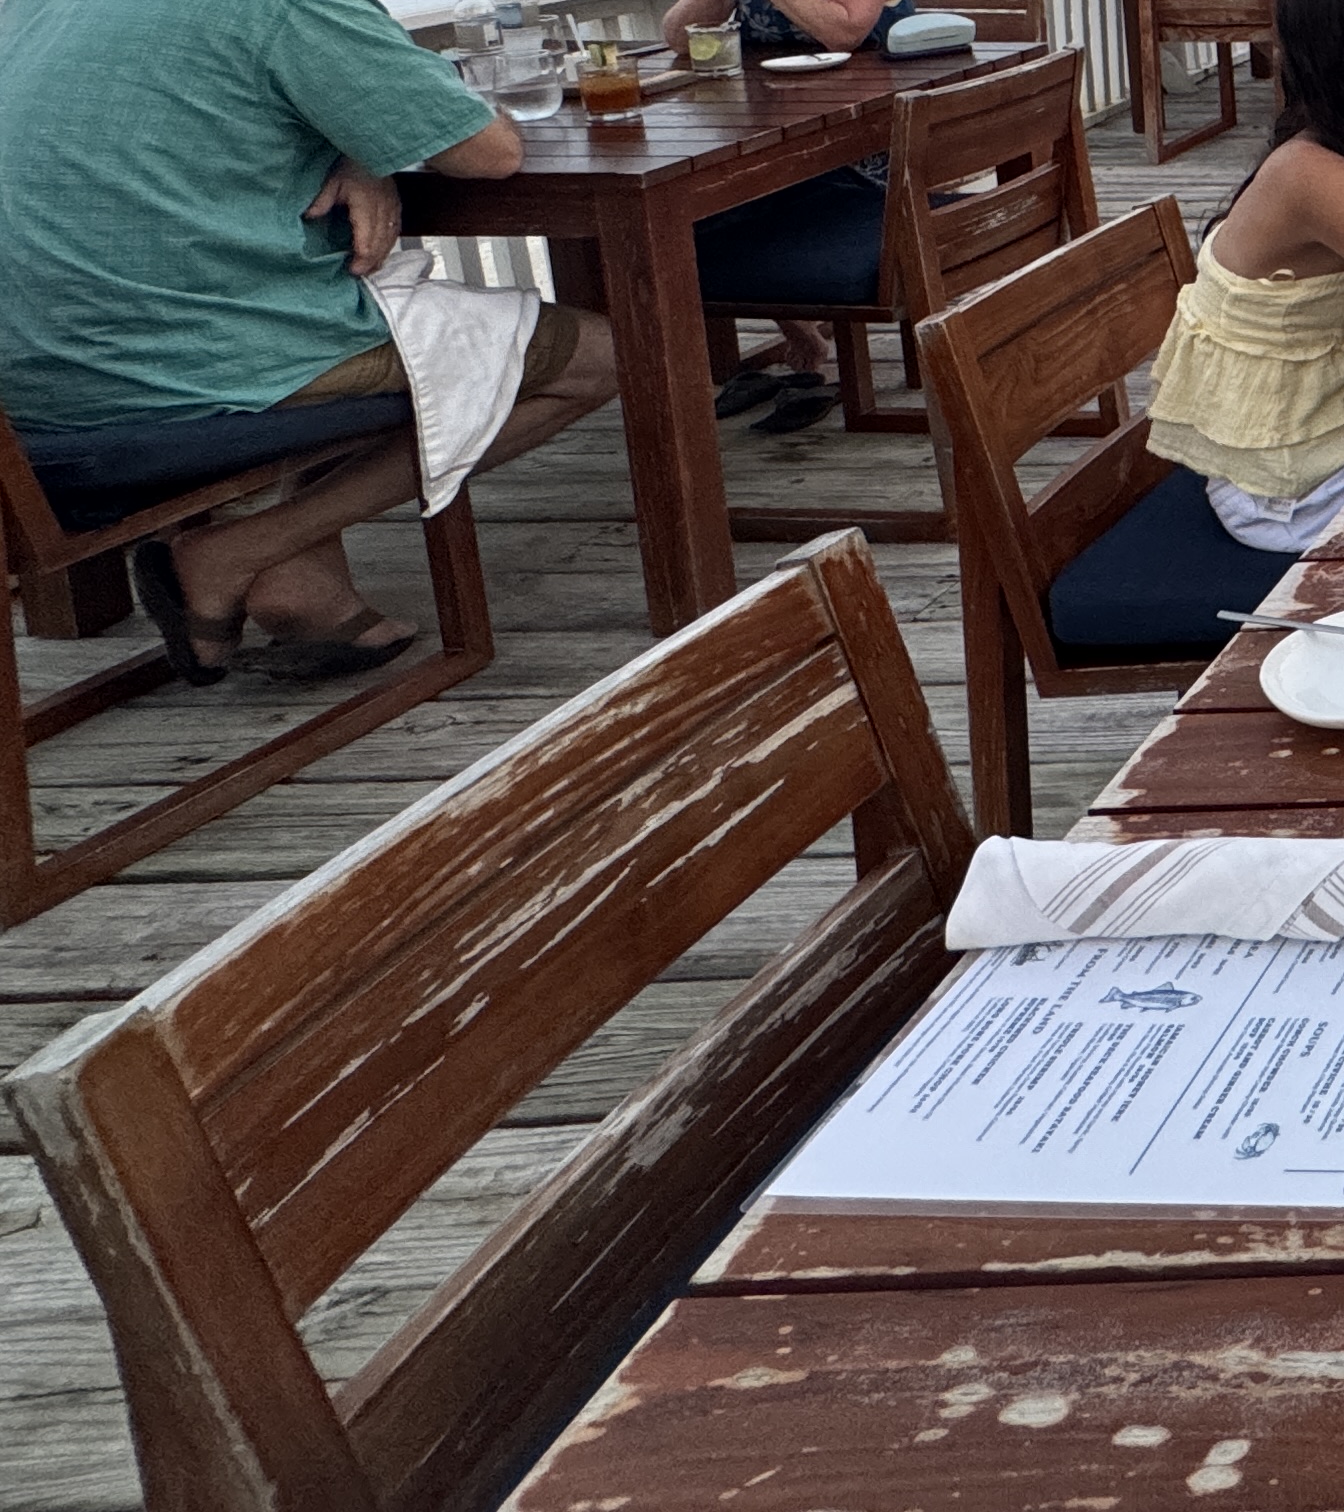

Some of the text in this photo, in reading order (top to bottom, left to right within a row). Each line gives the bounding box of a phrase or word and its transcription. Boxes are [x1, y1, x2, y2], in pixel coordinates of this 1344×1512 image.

[1077, 948, 1106, 977] FROM
[1059, 980, 1081, 1000] THE
[1032, 1003, 1062, 1033] LAND
[1300, 1021, 1327, 1057] SOUPS
